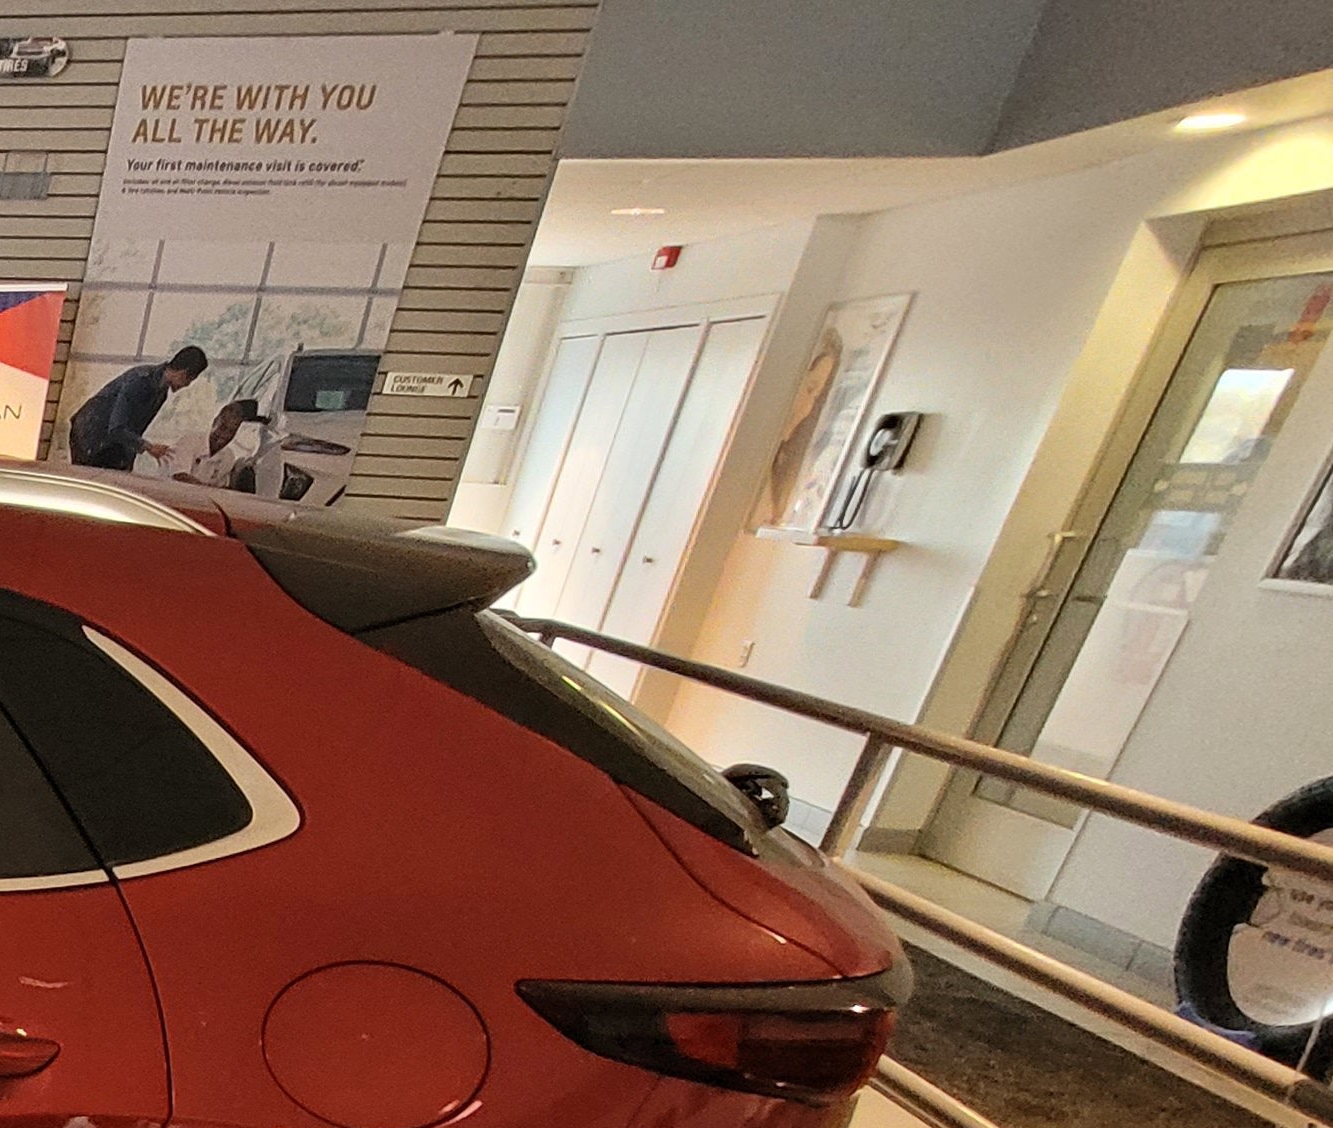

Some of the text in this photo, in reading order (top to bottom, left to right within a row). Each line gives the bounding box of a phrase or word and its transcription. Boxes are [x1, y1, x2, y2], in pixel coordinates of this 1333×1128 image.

[140, 83, 377, 111] WE'RE WITH YOU
[131, 118, 318, 145] ALL THE WAY.
[127, 159, 153, 172] Your
[156, 158, 182, 171] first
[184, 159, 263, 172] maintenance
[266, 159, 291, 172] visit
[294, 160, 305, 172] is
[393, 375, 444, 385] CUSTOMER
